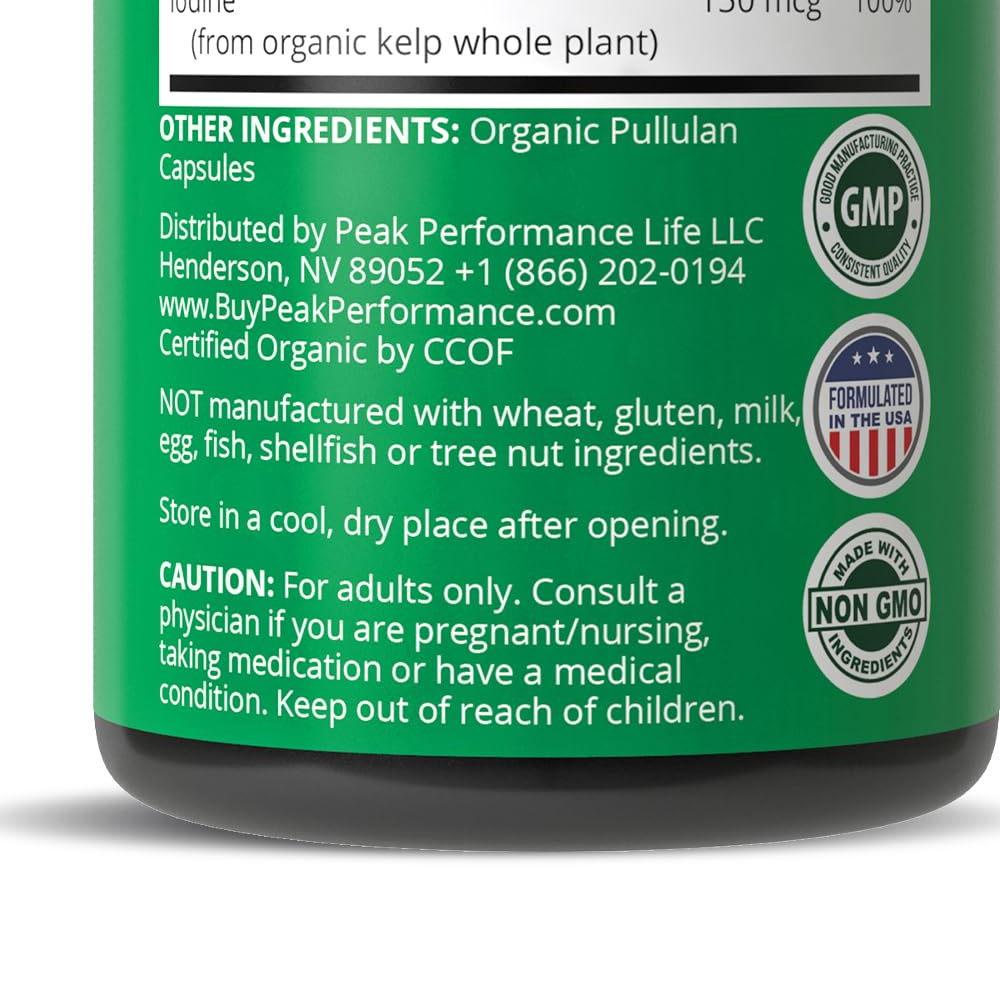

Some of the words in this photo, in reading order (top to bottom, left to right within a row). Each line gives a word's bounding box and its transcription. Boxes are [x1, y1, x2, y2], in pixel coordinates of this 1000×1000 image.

[191, 26, 253, 61] (from
[262, 27, 367, 64] organic
[378, 26, 442, 64] kelp
[452, 26, 553, 56] whole
[565, 26, 659, 65] plant)
[159, 114, 234, 143] OTHER
[242, 115, 459, 145] INGREDIENTS:
[470, 116, 600, 154] Organic
[611, 115, 737, 145] Pullulan
[159, 152, 255, 189] Capsules
[820, 172, 836, 204] GOOD
[835, 134, 899, 174] MANUFACTURING
[897, 151, 919, 201] PRACTICE
[841, 186, 904, 227] GMP
[160, 212, 284, 243] Distributed
[293, 214, 327, 253] by
[336, 215, 409, 245] Peak
[419, 216, 634, 246] Performance
[645, 215, 701, 246] Life
[712, 217, 764, 245] LLC
[160, 251, 290, 287] Henderson,
[300, 255, 342, 284] NV
[349, 256, 445, 286] 89052
[455, 258, 489, 286] +1
[505, 258, 587, 291] (866)
[598, 257, 746, 286] 202-0194
[831, 242, 881, 279] CONSISTENT
[883, 239, 911, 276] QUALITY
[159, 292, 615, 329] www.BuyPeakPerformance.com
[159, 328, 249, 360] Certified
[257, 333, 367, 371] Organic
[377, 334, 415, 373] by
[424, 337, 514, 366] CCOF
[160, 387, 204, 417] NOT
[209, 393, 403, 426] manufactured
[413, 397, 482, 427] with
[493, 397, 603, 431] wheat,
[614, 397, 723, 436] gluten,
[735, 394, 801, 426] milk,
[829, 383, 912, 410] FORMULATED
[829, 414, 845, 429] IN
[851, 413, 881, 427] THE
[885, 411, 912, 425] USA
[159, 432, 198, 465] egg,
[204, 428, 252, 464] fish,
[260, 432, 376, 465] shellfish
[387, 443, 422, 466] or
[430, 440, 497, 467] tree
[508, 441, 564, 467] nut
[575, 436, 761, 476] ingredients.
[159, 496, 212, 528] Store
[219, 500, 239, 530] in
[246, 509, 261, 531] a
[270, 505, 333, 539] cool,
[343, 506, 394, 546] dry
[403, 508, 488, 546] place
[498, 509, 578, 539] after
[588, 509, 727, 547] opening.
[833, 541, 873, 581] MADE
[878, 540, 909, 575] WITH
[159, 560, 274, 598] CAUTION:
[284, 571, 329, 601] For
[337, 573, 433, 604] adults
[443, 575, 521, 614] only.
[532, 575, 658, 606] Consult
[668, 582, 685, 604] a
[816, 593, 868, 624] NON
[876, 588, 921, 619] GMO
[160, 599, 260, 638] physician
[268, 608, 286, 638] if
[291, 617, 344, 647] you
[353, 620, 404, 643] are
[415, 615, 709, 654] pregnant/nursing,
[159, 638, 221, 680] taking
[228, 647, 381, 682] medication
[391, 661, 426, 684] or
[436, 654, 513, 685] have
[524, 664, 541, 685] a
[555, 654, 681, 685] medical
[828, 626, 912, 674] INGREDIENTS
[159, 680, 268, 715] condition.
[277, 689, 347, 729] Keep
[356, 697, 409, 723] out
[418, 694, 452, 724] of
[461, 695, 552, 725] reach
[563, 695, 599, 725] of
[607, 694, 744, 725] children.
